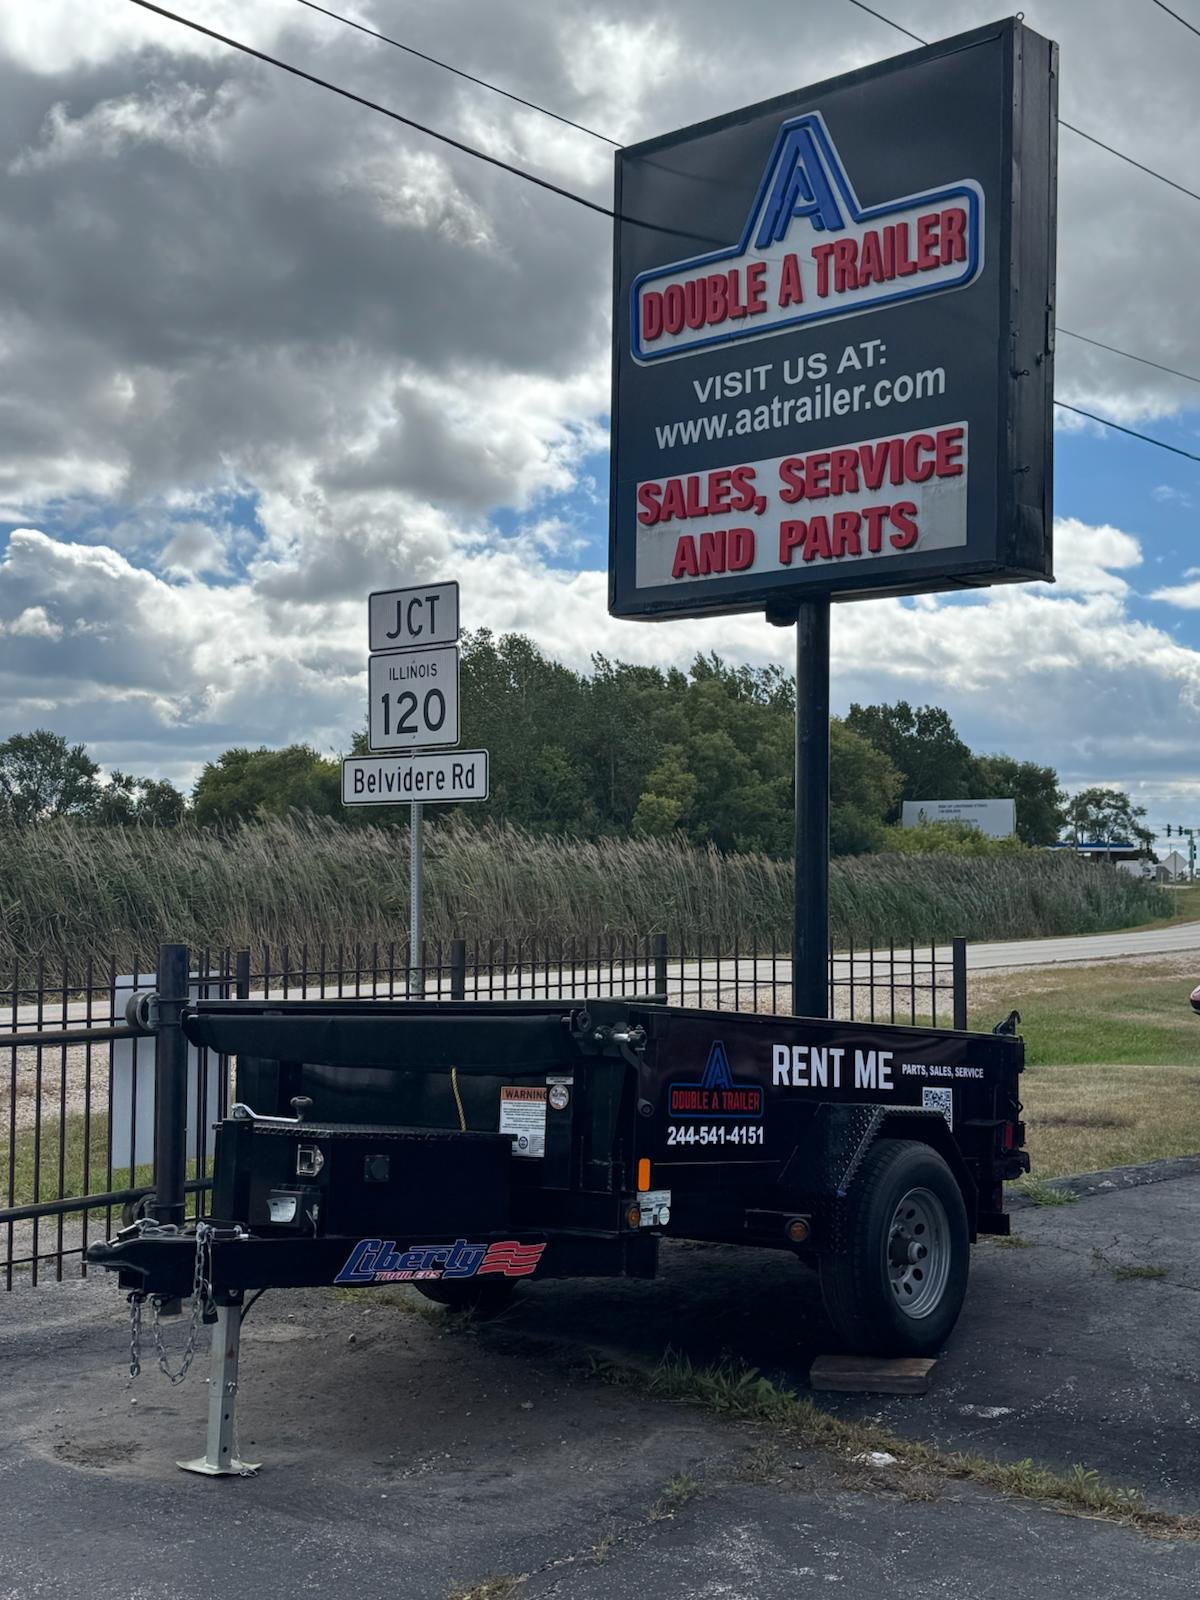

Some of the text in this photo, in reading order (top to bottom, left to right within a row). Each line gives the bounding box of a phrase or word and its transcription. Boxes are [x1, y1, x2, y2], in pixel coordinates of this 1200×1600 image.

[642, 207, 967, 341] DOUBLE A TRAILER
[693, 339, 887, 403] VISIT US AT:
[655, 367, 946, 449] www.aatrailer.com
[637, 427, 964, 526] SALES, SERVICE
[671, 501, 919, 578] AND PARTS
[386, 595, 440, 639] JCT
[389, 663, 438, 681] ILLINOIS
[381, 688, 446, 735] 120
[354, 763, 475, 794] Belvidere Rd
[772, 1044, 894, 1090] RENT ME
[902, 1063, 984, 1079] PARTS, SALES, SERVICE
[672, 1090, 760, 1111] DOUBLE A TRAILER
[667, 1126, 764, 1145] 244-541-4151
[334, 1238, 488, 1283] Liberty
[374, 1270, 443, 1281] TRAILERS
